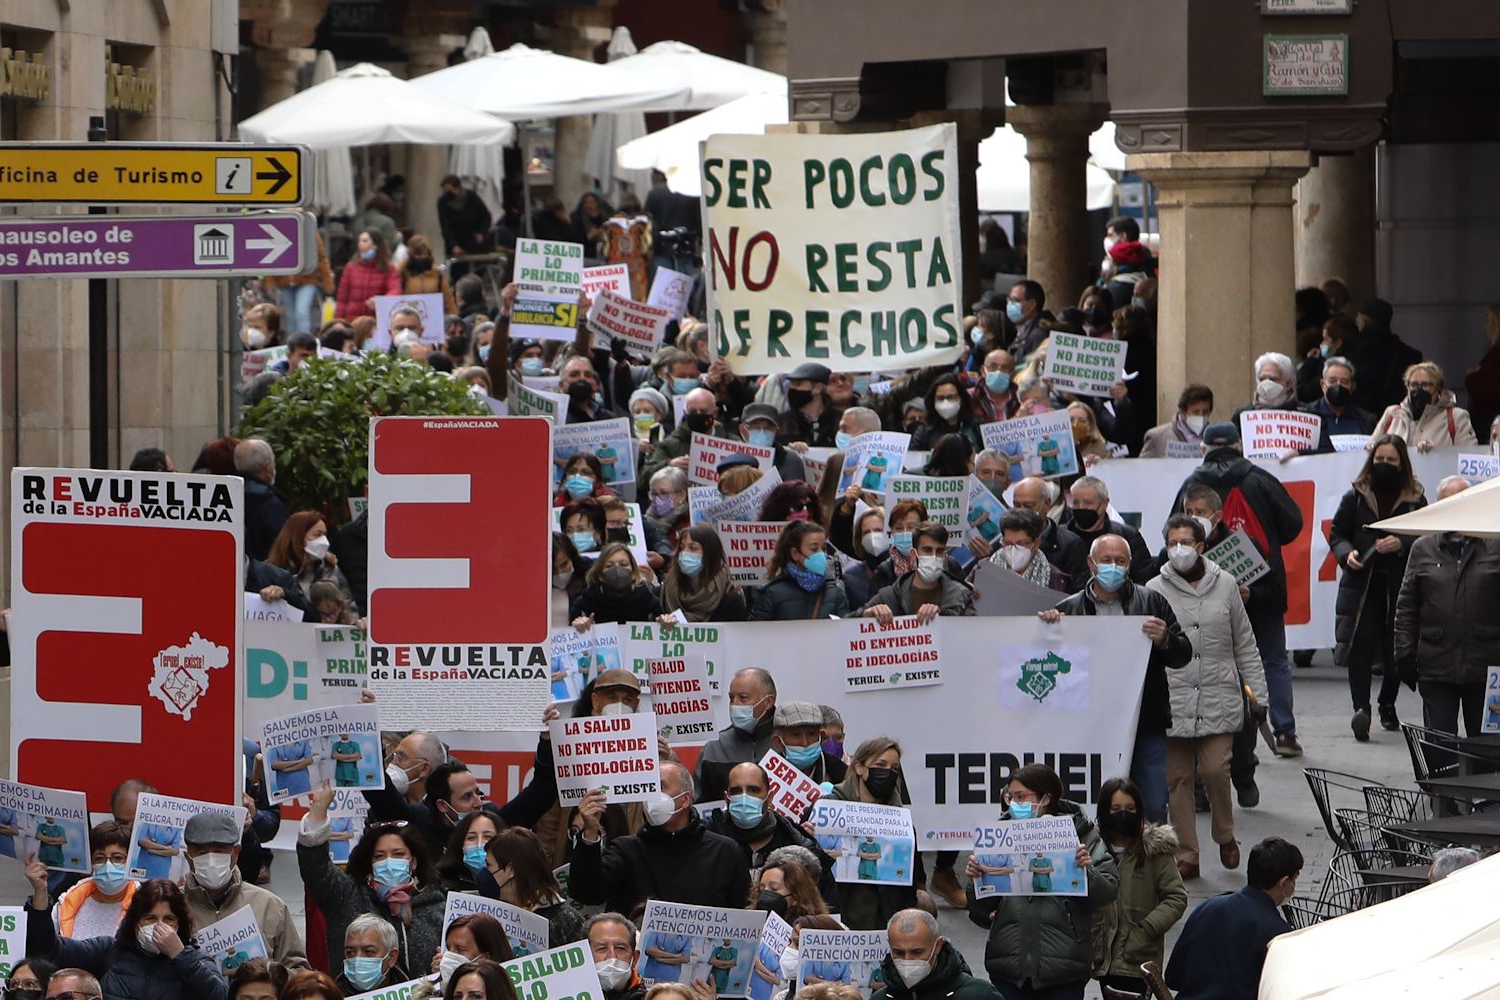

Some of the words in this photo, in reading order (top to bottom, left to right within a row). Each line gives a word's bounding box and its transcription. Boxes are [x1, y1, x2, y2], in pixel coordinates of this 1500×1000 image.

[73, 168, 99, 183] de
[114, 167, 203, 184] Turismo
[704, 159, 771, 208] SER
[804, 150, 945, 209] POCOS
[105, 227, 132, 243] de
[26, 249, 130, 266] Amantes
[709, 226, 779, 292] NO
[806, 237, 951, 293] RESTA
[521, 268, 580, 283] PRIMERO
[713, 304, 958, 358] DERECHOS
[1055, 334, 1079, 348] SER
[1083, 338, 1121, 353] POCOS
[1057, 349, 1072, 361] NO
[1075, 351, 1115, 367] RESTA
[423, 421, 499, 431] #EspañaVACIADA
[1255, 424, 1271, 436] NO
[1276, 424, 1312, 439] TIENE
[22, 475, 234, 510] REVUELTA
[893, 481, 920, 493] SER
[925, 479, 964, 493] POCOS
[23, 500, 45, 515] de
[51, 499, 67, 515] la
[73, 501, 233, 524] EspañaVACIADA
[321, 630, 345, 642] LA
[850, 640, 867, 652] NO
[870, 634, 932, 650] ENTIENDE
[371, 646, 548, 667] REVUELTA
[662, 643, 684, 657] LO
[846, 657, 863, 669] DE
[866, 650, 939, 667] IDEOLOGÍAS
[322, 679, 358, 688] TERUEL
[371, 667, 388, 680] de
[393, 667, 407, 680] la
[411, 668, 547, 682] EspañaVACIADA
[847, 675, 886, 687] TERUEL
[905, 670, 939, 682] EXISTE
[264, 713, 322, 737] ¡SALVEMOS
[325, 710, 339, 722] LA
[565, 722, 580, 735] LA
[584, 717, 630, 734] SALUD
[677, 722, 714, 734] EXISTE
[265, 726, 317, 749] ATENCIÓN
[320, 721, 376, 739] PRIMARIA!
[558, 743, 573, 757] NO
[575, 737, 647, 755] ENTIENDE
[557, 765, 571, 778] DE
[573, 757, 655, 777] IDEOLOGÍAS
[766, 756, 798, 784] SER
[30, 788, 45, 800] LA
[614, 783, 656, 795] EXISTE
[27, 802, 84, 820] PRIMARIA!
[974, 827, 1014, 849] 25%
[649, 905, 711, 923] ¡SALVEMOS
[715, 911, 728, 923] LA
[647, 919, 704, 935] ATENCIÓN
[707, 924, 761, 940] PRIMARIA!
[803, 934, 862, 947] ¡SALVEMOS
[869, 934, 882, 945] LA
[509, 947, 585, 984] SALUD
